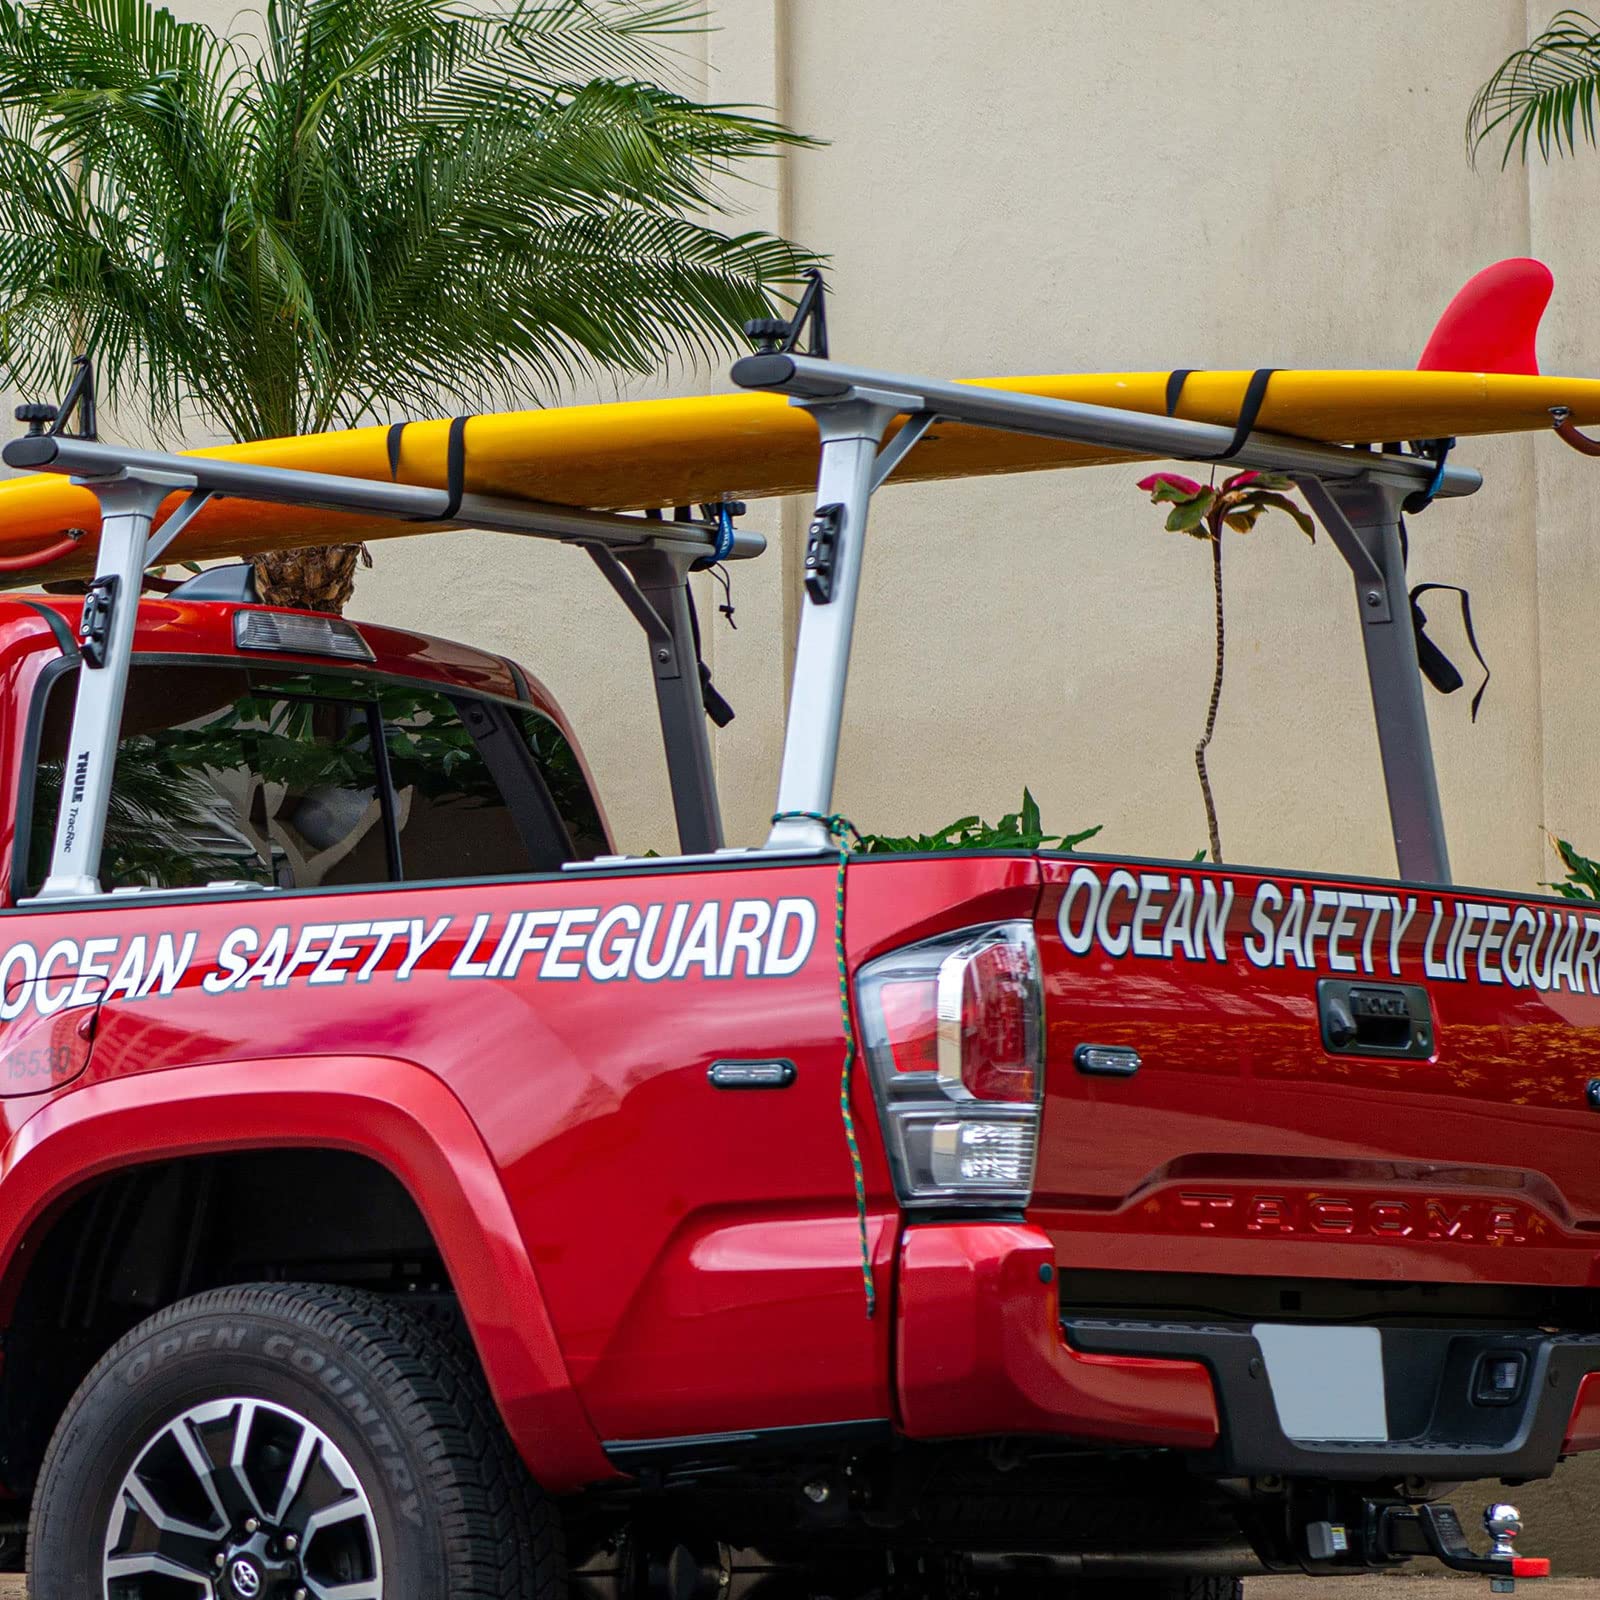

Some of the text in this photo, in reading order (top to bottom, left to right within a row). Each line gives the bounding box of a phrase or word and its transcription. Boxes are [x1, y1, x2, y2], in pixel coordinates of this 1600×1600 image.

[63, 751, 90, 853] THULE TracRac
[0, 897, 818, 1021] OCEAN SAFETY LIFEGUARD
[1057, 867, 1600, 996] OCEAN SAFETY LIFEGUAR
[7, 1045, 71, 1078] 15530
[1178, 1191, 1528, 1243] TACOMA
[126, 1327, 424, 1527] OPEN COUNTRY
